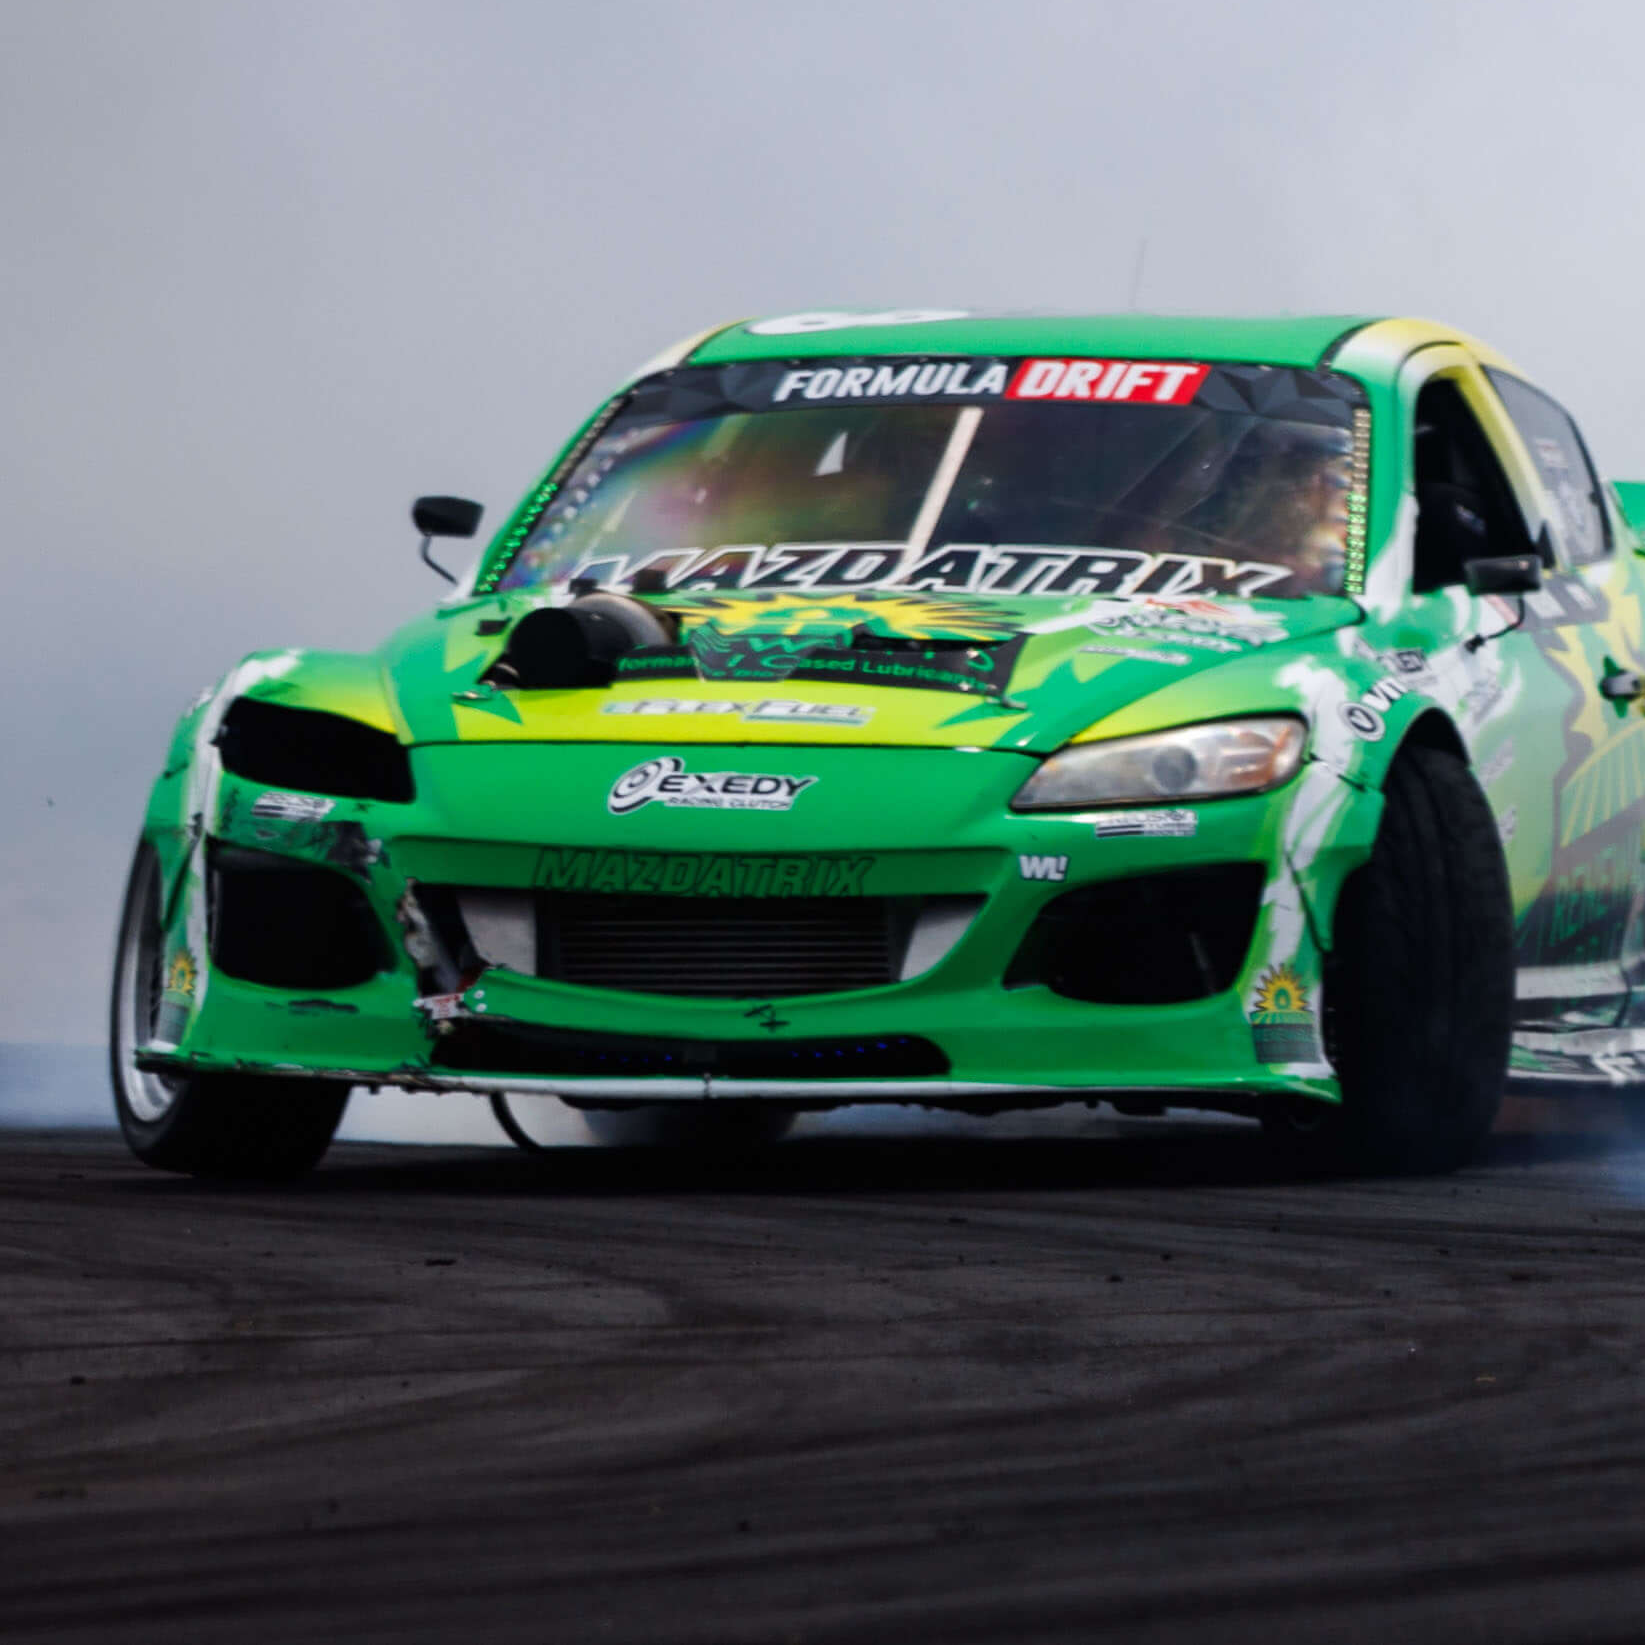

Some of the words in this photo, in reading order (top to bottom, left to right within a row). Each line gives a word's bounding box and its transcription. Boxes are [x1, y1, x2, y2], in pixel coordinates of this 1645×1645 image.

[772, 363, 1008, 404] FORMULA
[1014, 360, 1204, 403] DRIFT
[572, 541, 1294, 598] MAZDATRIX
[657, 774, 816, 797] EXEDY
[533, 847, 877, 899] MAZDATRIX
